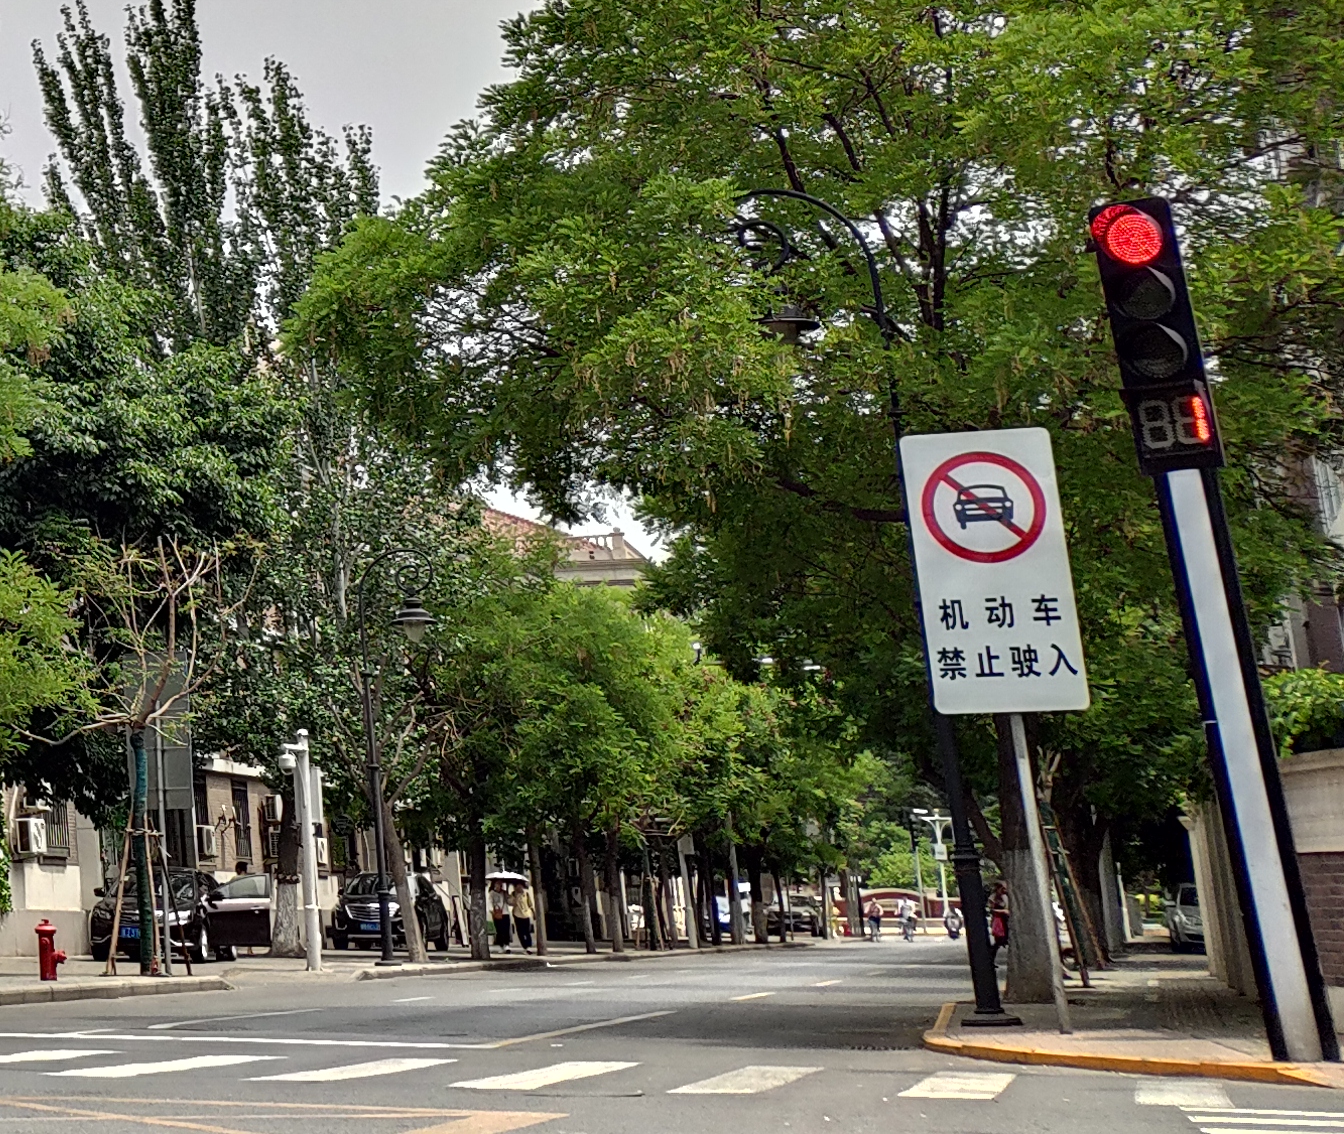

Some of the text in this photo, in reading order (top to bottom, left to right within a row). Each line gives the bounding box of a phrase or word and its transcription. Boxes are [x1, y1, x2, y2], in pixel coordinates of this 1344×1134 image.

[939, 593, 1064, 632] 机动车
[936, 643, 1079, 681] 禁止驶入
